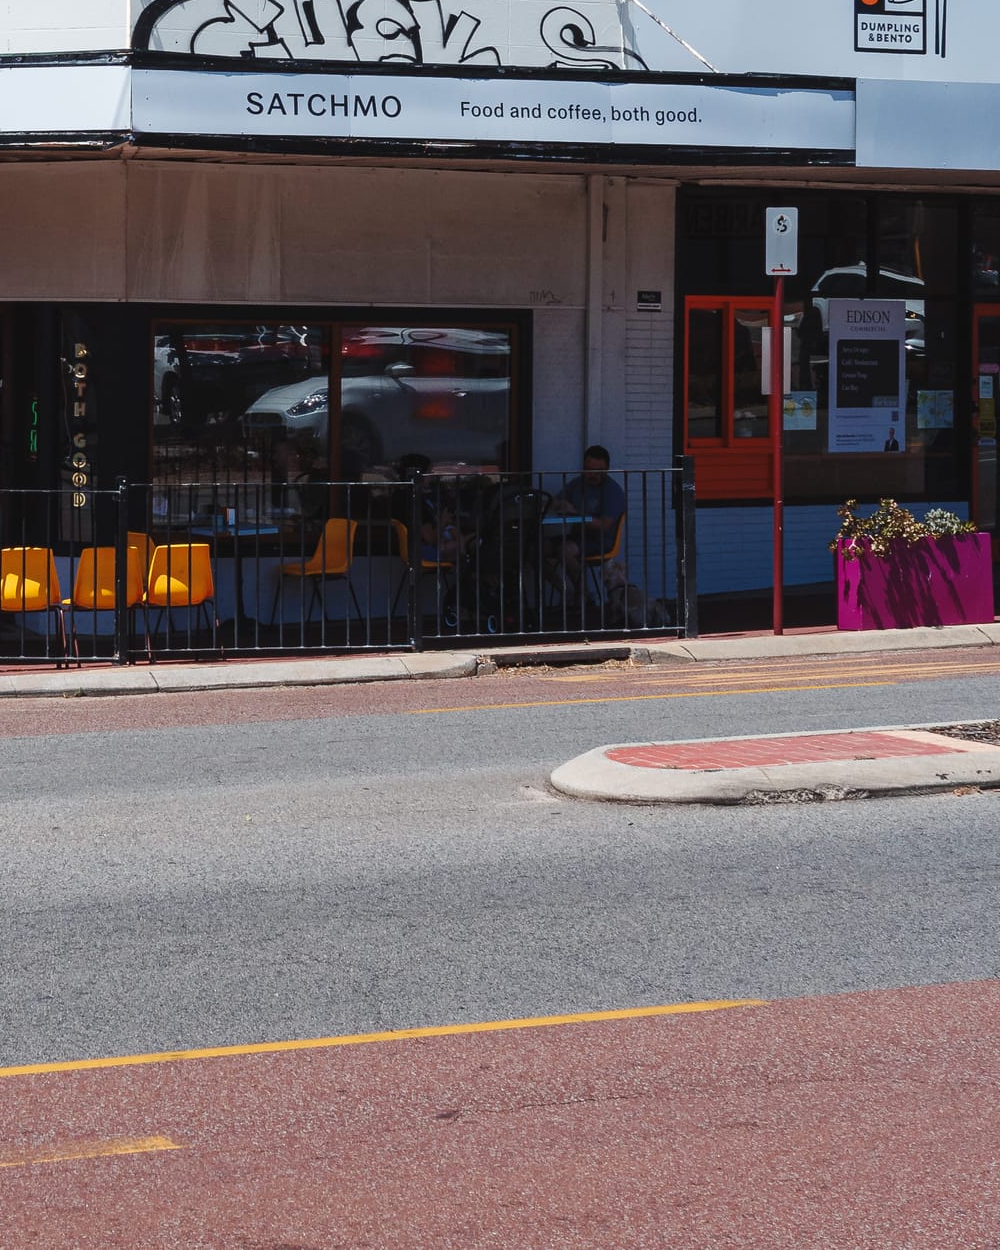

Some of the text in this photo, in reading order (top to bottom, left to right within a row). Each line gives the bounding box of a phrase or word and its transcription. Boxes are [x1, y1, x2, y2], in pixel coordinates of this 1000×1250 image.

[861, 21, 920, 33] DUMPLING
[246, 92, 702, 126] SATCHMO Food and coffee, both good.
[847, 309, 891, 324] EDISON
[72, 343, 88, 508] BOTH GOOD
